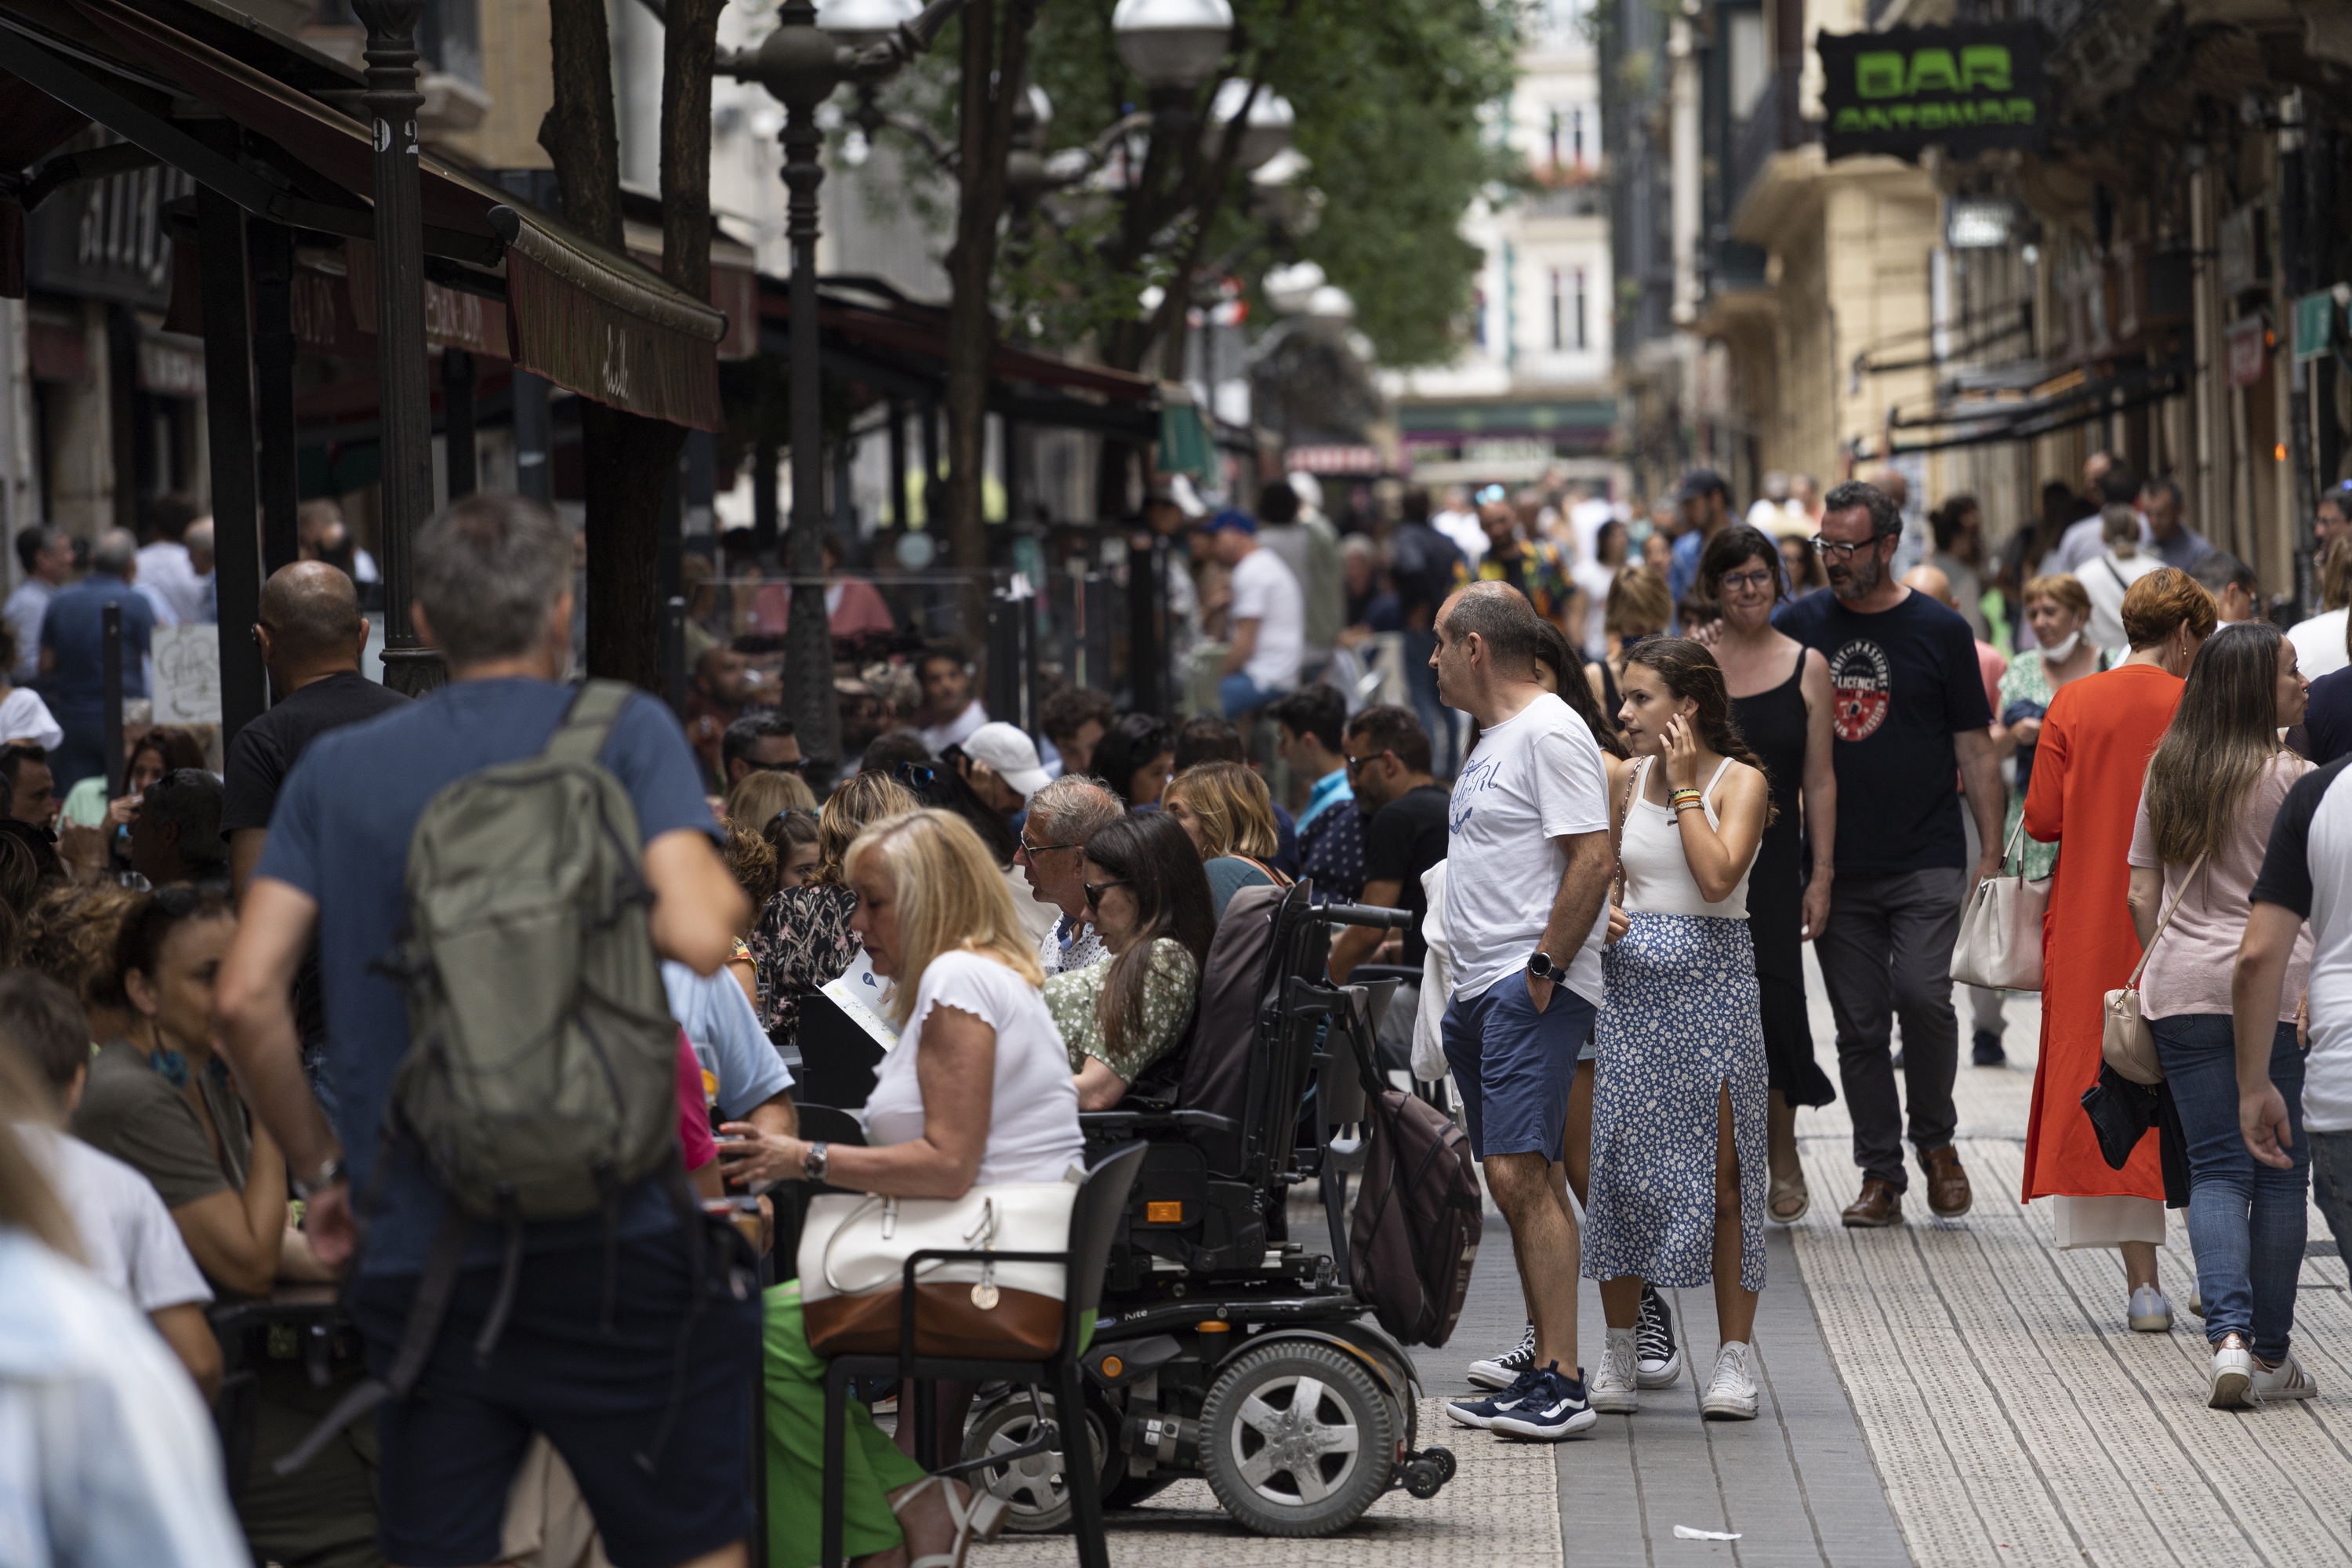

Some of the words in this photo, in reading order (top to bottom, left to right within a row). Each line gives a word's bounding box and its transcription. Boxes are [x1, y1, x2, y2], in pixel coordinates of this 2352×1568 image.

[1855, 42, 2013, 100] BAR
[1837, 675, 1877, 691] LICENCE
[1854, 640, 1889, 688] PASSIONS
